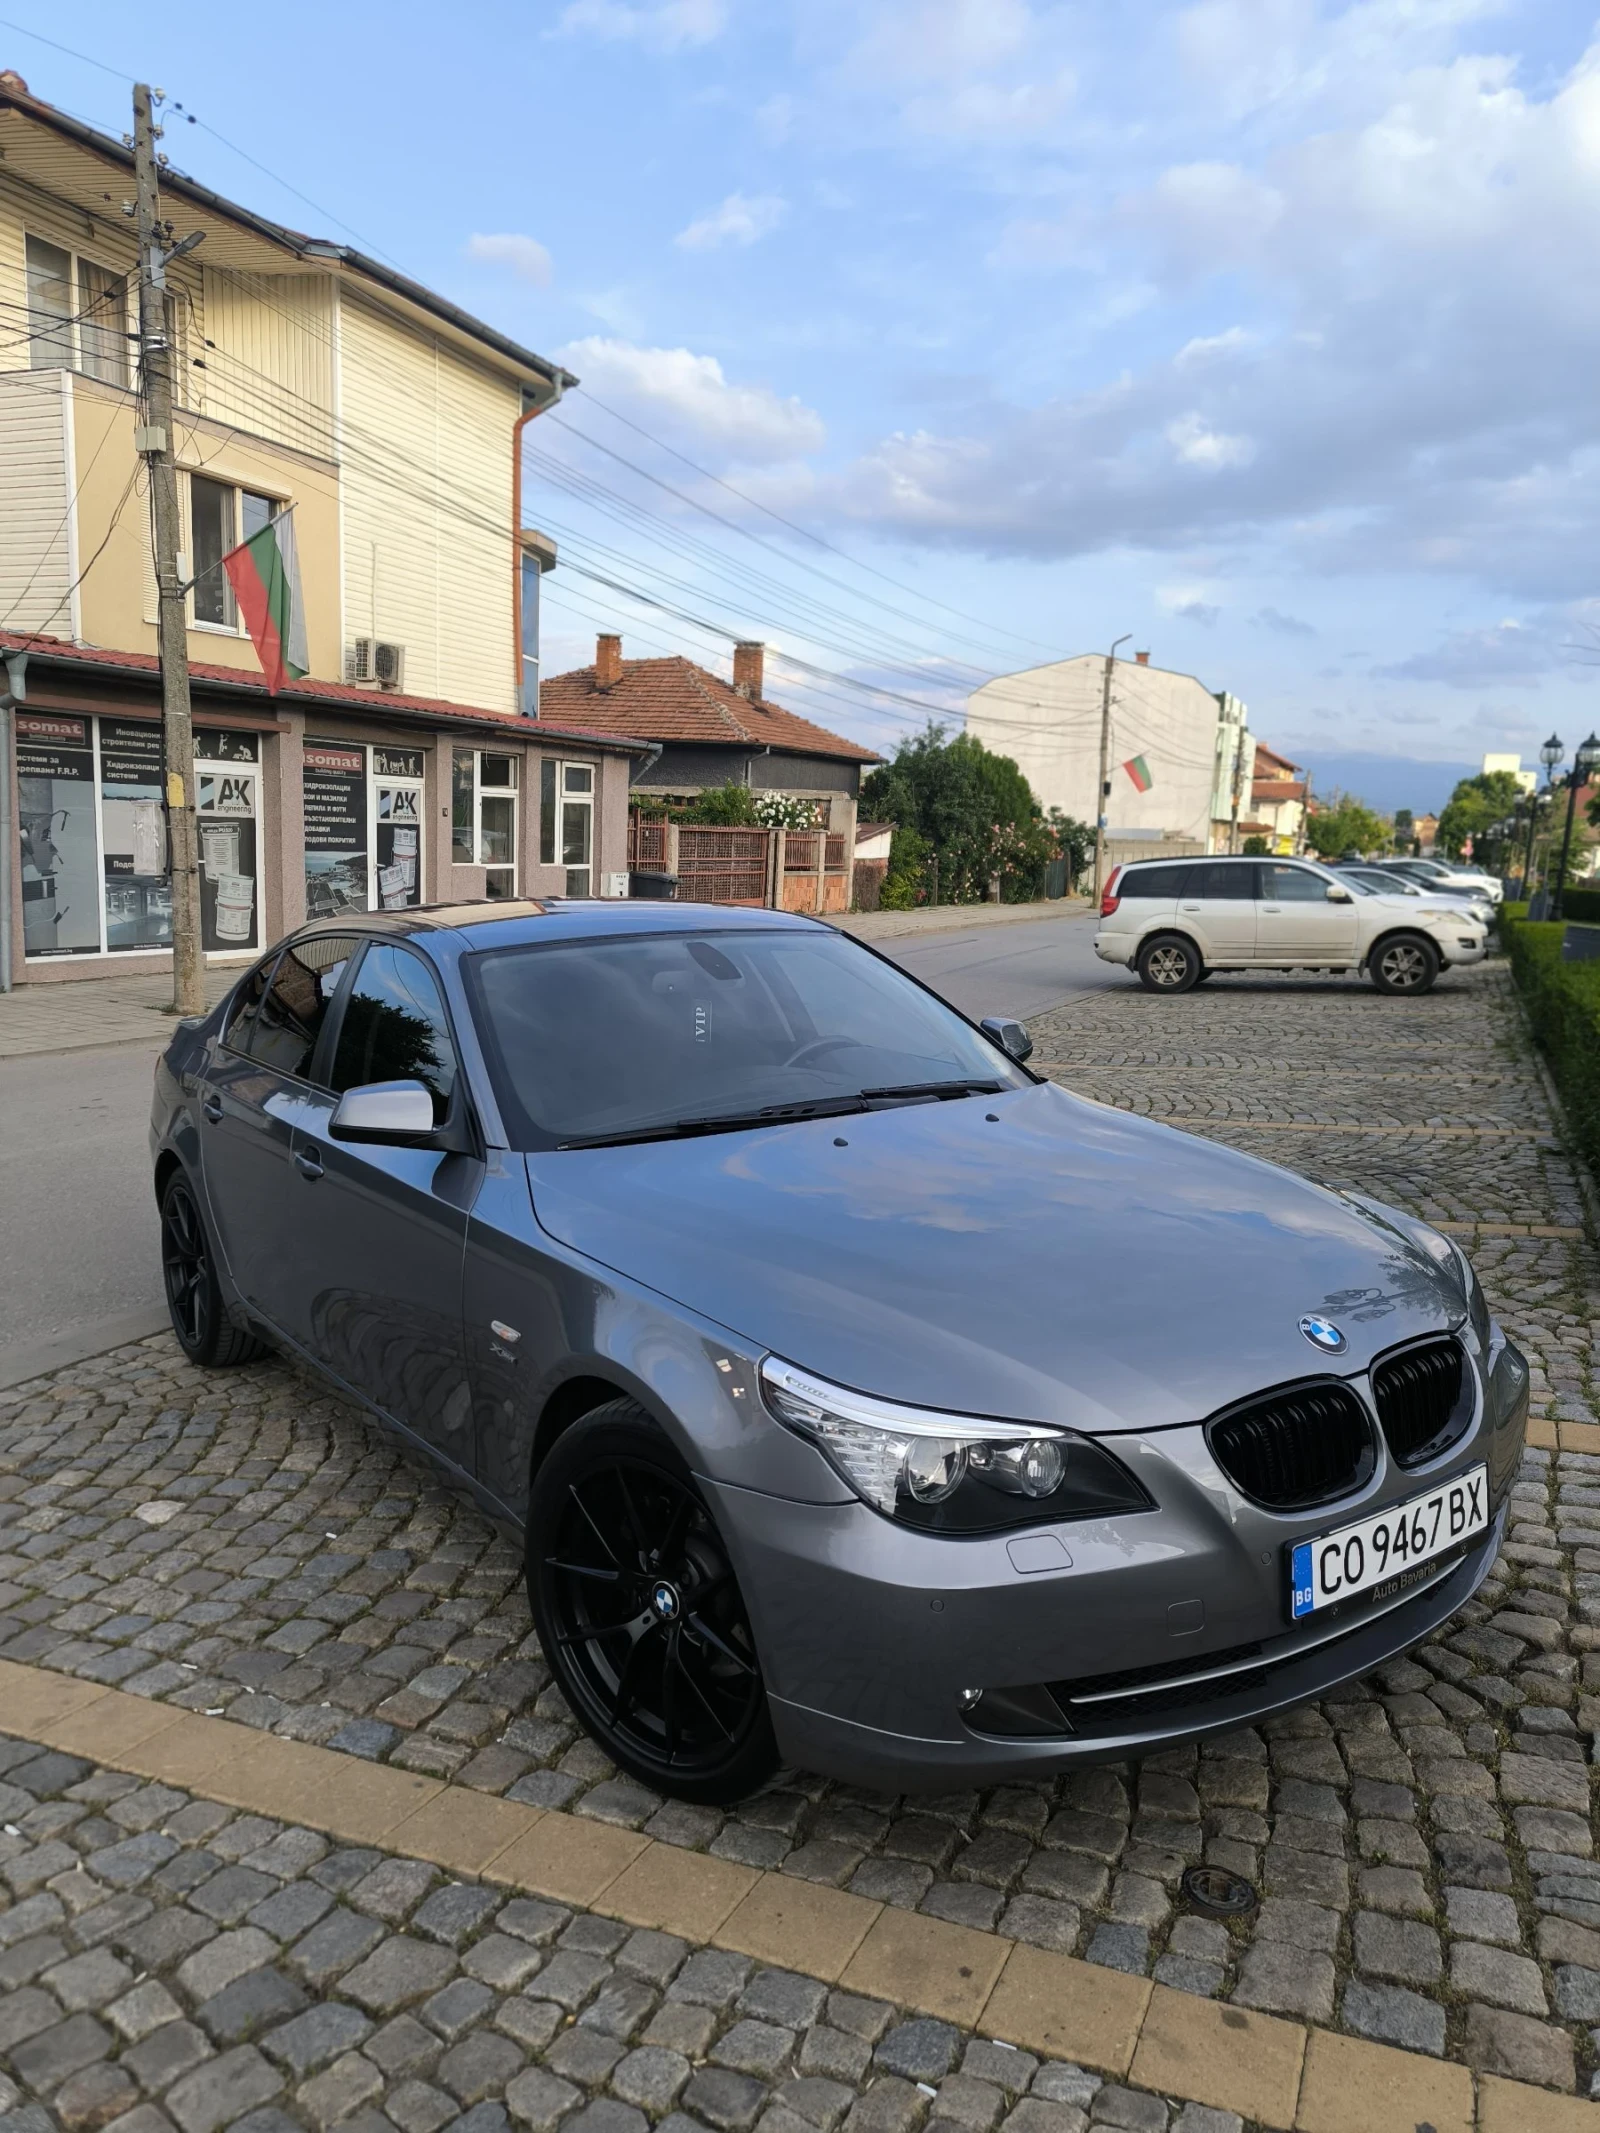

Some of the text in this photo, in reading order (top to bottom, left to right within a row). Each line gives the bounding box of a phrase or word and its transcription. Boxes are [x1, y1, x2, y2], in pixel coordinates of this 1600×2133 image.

[17, 720, 82, 735] somat
[16, 754, 48, 763] истеми
[106, 760, 160, 772] Хидроизолаци
[218, 778, 251, 806] AK
[392, 791, 417, 815] AK
[695, 1007, 706, 1036] VIP
[1319, 1476, 1483, 1596] CO 9467 BX
[1372, 1561, 1437, 1602] Auto Bavaria
[1295, 1587, 1312, 1607] BG
